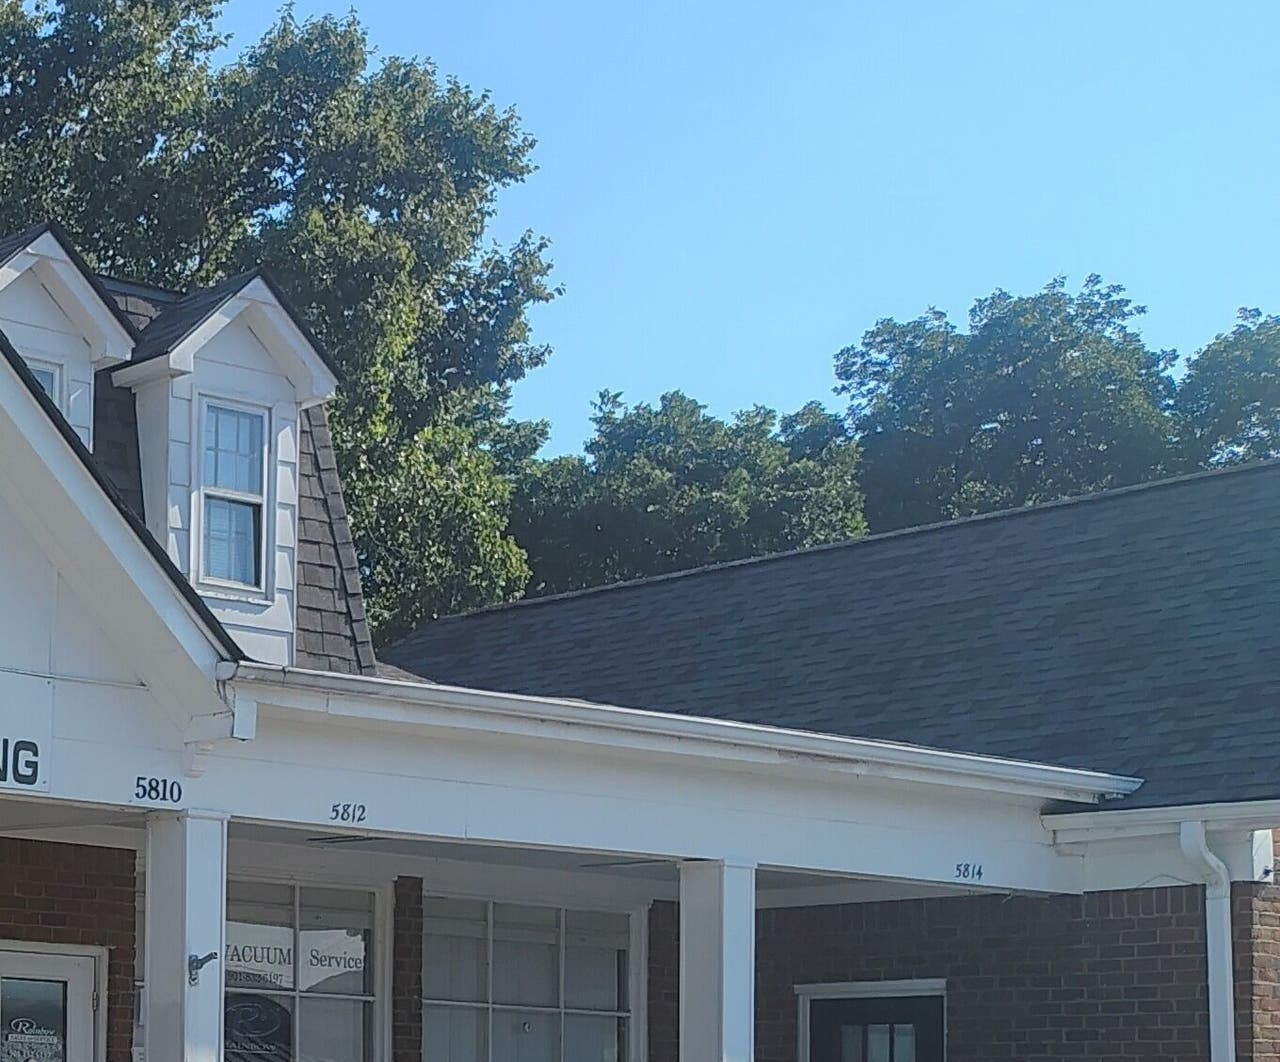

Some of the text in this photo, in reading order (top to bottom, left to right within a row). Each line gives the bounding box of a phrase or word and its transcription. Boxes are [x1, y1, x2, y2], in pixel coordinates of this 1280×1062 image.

[134, 776, 183, 803] 5810
[329, 802, 367, 823] 5812
[954, 863, 984, 881] 5814
[309, 948, 363, 969] Service
